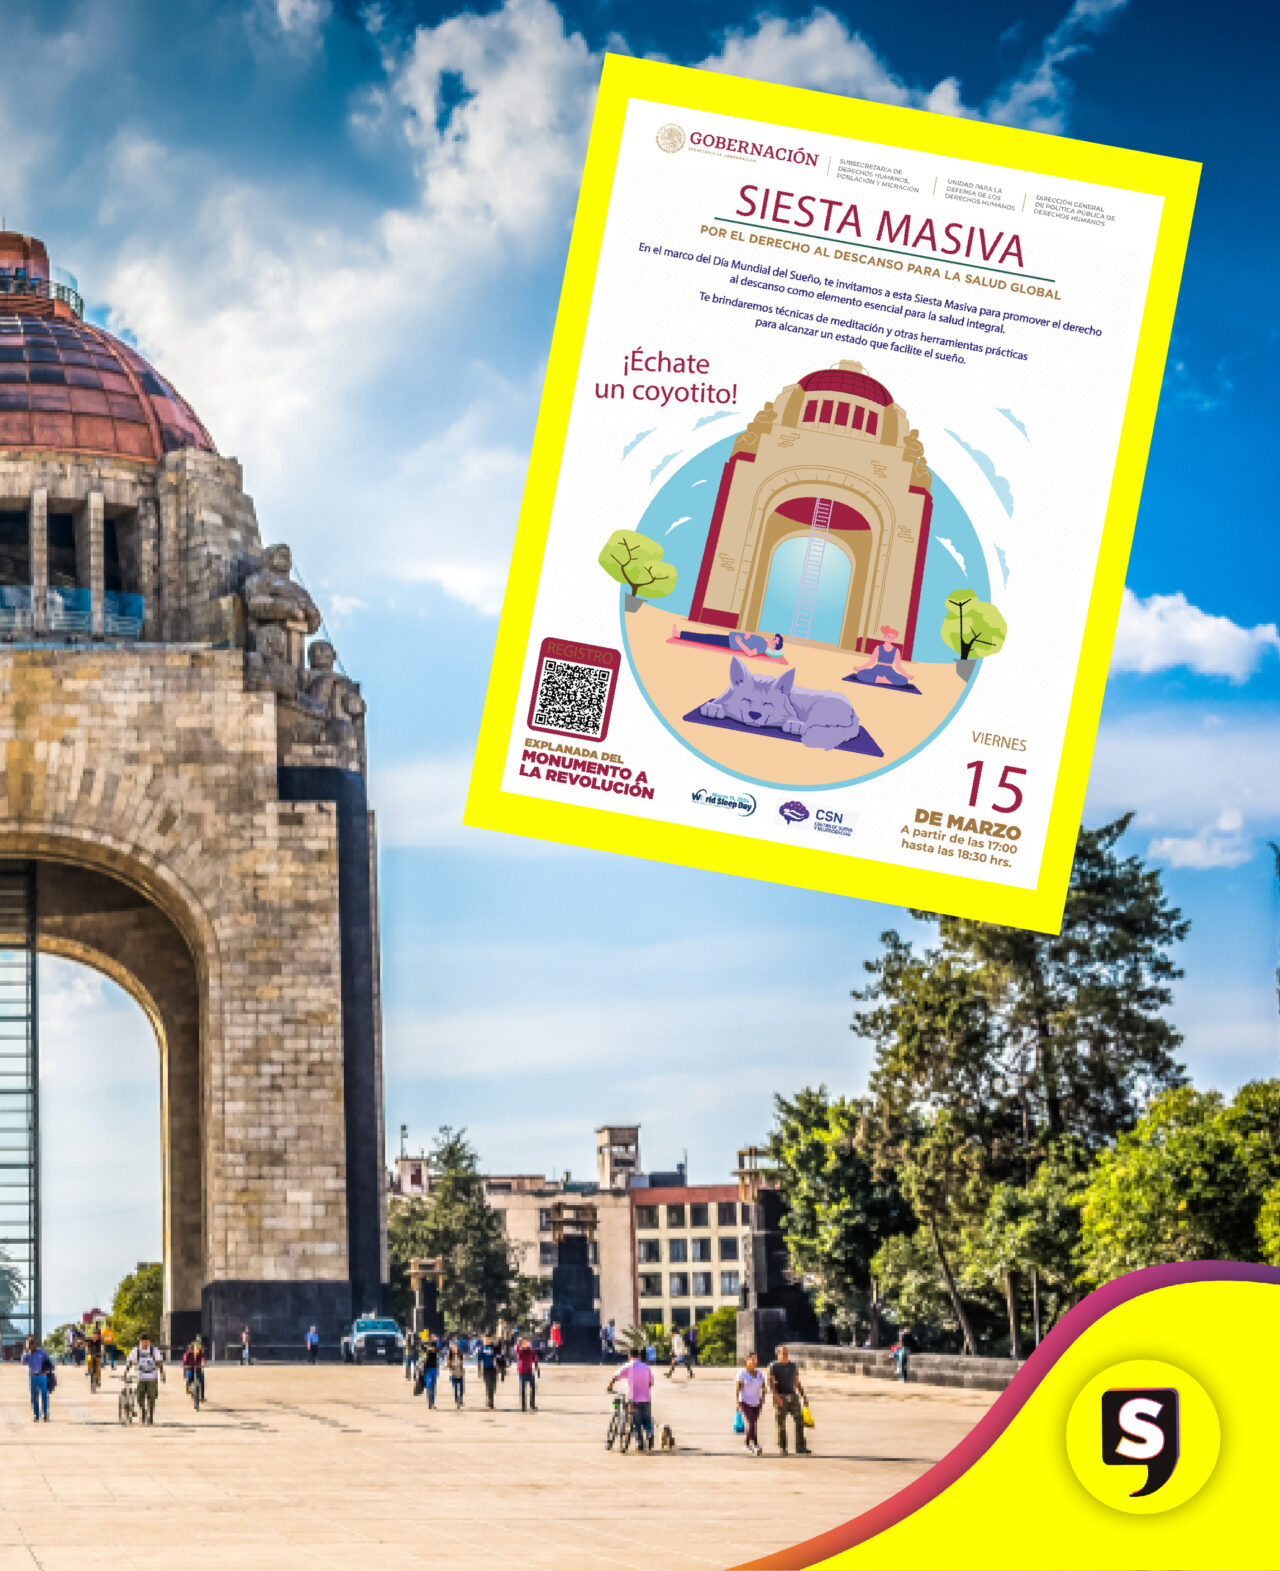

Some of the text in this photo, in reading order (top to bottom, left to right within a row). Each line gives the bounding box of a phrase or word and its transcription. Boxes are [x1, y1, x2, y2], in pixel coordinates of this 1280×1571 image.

[690, 132, 819, 167] GOBERNACIÓN
[736, 185, 1024, 268] SIESTA MASIVA
[700, 225, 1061, 300] POR EL DERECHO AL DESCANSO PARA LA SALUD GLOBAL
[639, 242, 651, 253] En
[653, 246, 662, 255] el
[664, 249, 694, 260] marco
[696, 253, 711, 264] del
[713, 256, 729, 267] Día
[731, 260, 771, 275] Mundial
[773, 267, 788, 278] del
[790, 271, 821, 286] Sueño,
[825, 278, 834, 287] te
[836, 279, 882, 296] invitamos
[893, 292, 912, 301] esta
[914, 294, 942, 307] Siesta
[944, 299, 977, 313] Masiva
[979, 308, 1001, 318] para
[1003, 312, 1051, 326] promover
[1052, 320, 1061, 329] el
[1063, 322, 1102, 336] derecho
[730, 275, 1005, 334] al descanso como elemento esencial para la salud integral.
[700, 291, 1028, 360] Te brindaremos técnicas de meditación y otras herramientas prácticas
[755, 319, 966, 364] para alcanzar un estado que facilite el sueño.
[624, 346, 710, 376] ¡Échate
[595, 382, 737, 407] un coyotito!
[547, 641, 613, 665] REGISTRO
[525, 738, 624, 764] EXPLANADA DEL
[972, 730, 1028, 752] VIERNES
[519, 764, 655, 800] LA REVOLUCIÓN
[522, 749, 648, 784] MONUMENTO A
[967, 760, 1027, 814] 15
[738, 801, 753, 812] Day
[816, 809, 843, 824] CSN
[900, 825, 1017, 854] A partir de las 17:00
[914, 808, 1021, 841] DE MARZO
[901, 838, 1011, 868] hasta las 18:30 hrs.
